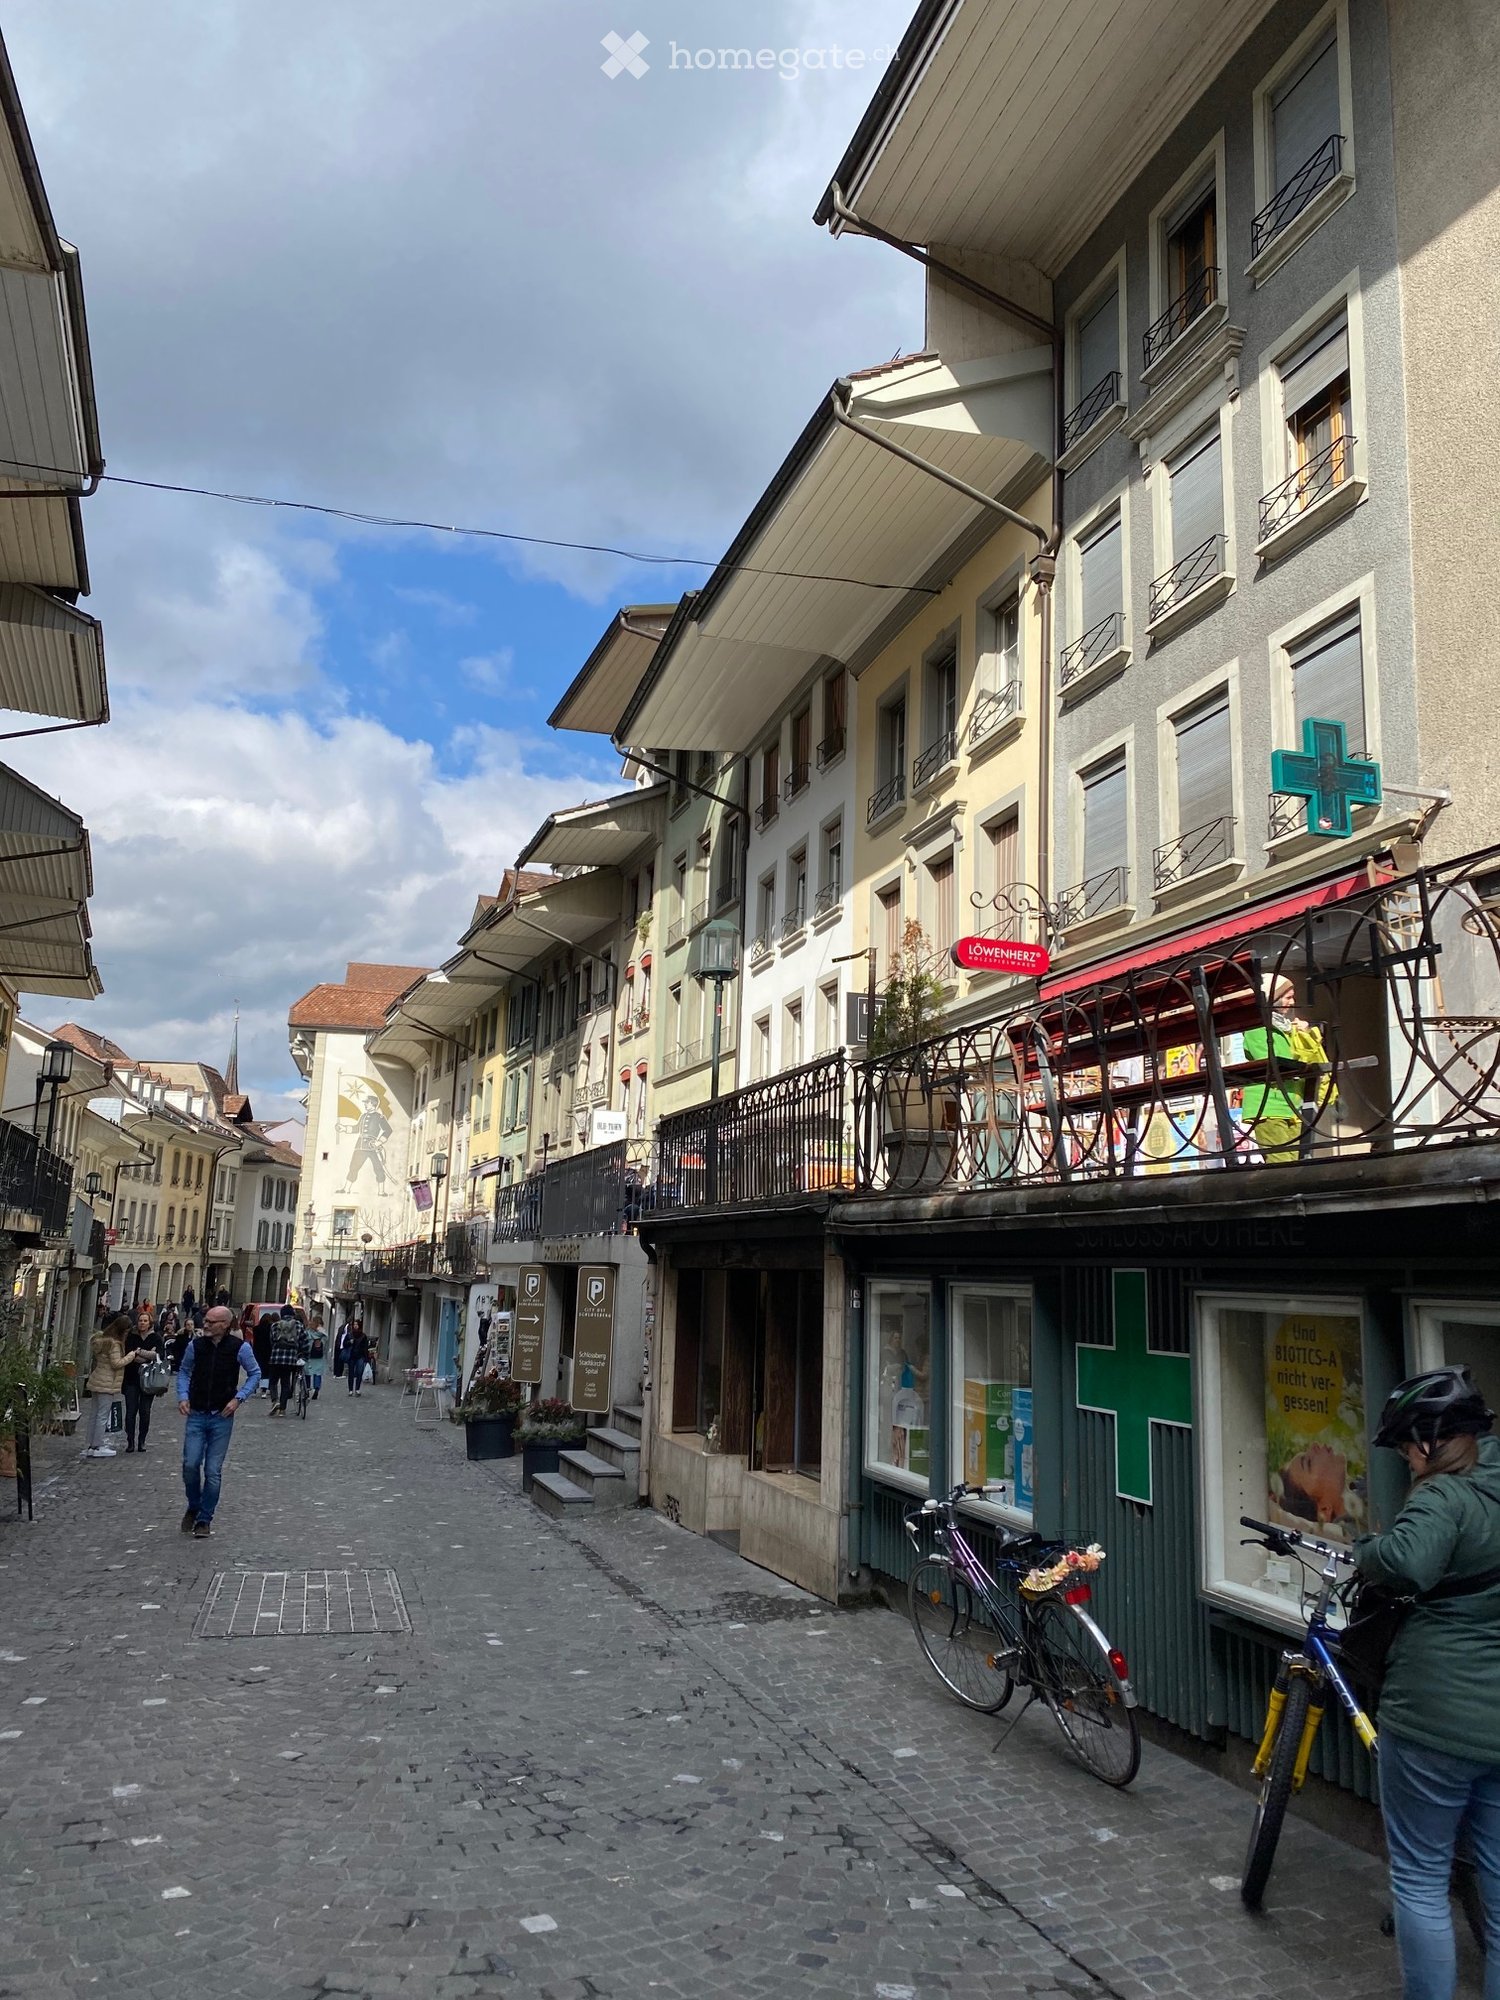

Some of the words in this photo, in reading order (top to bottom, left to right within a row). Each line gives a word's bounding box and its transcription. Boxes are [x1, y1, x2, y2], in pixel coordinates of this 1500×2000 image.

[1292, 1322, 1317, 1342] Und
[1275, 1345, 1337, 1368] BIOTICS-A
[1277, 1368, 1307, 1388] nicht
[1311, 1376, 1336, 1391] ver-
[1283, 1395, 1329, 1415] gessen!
